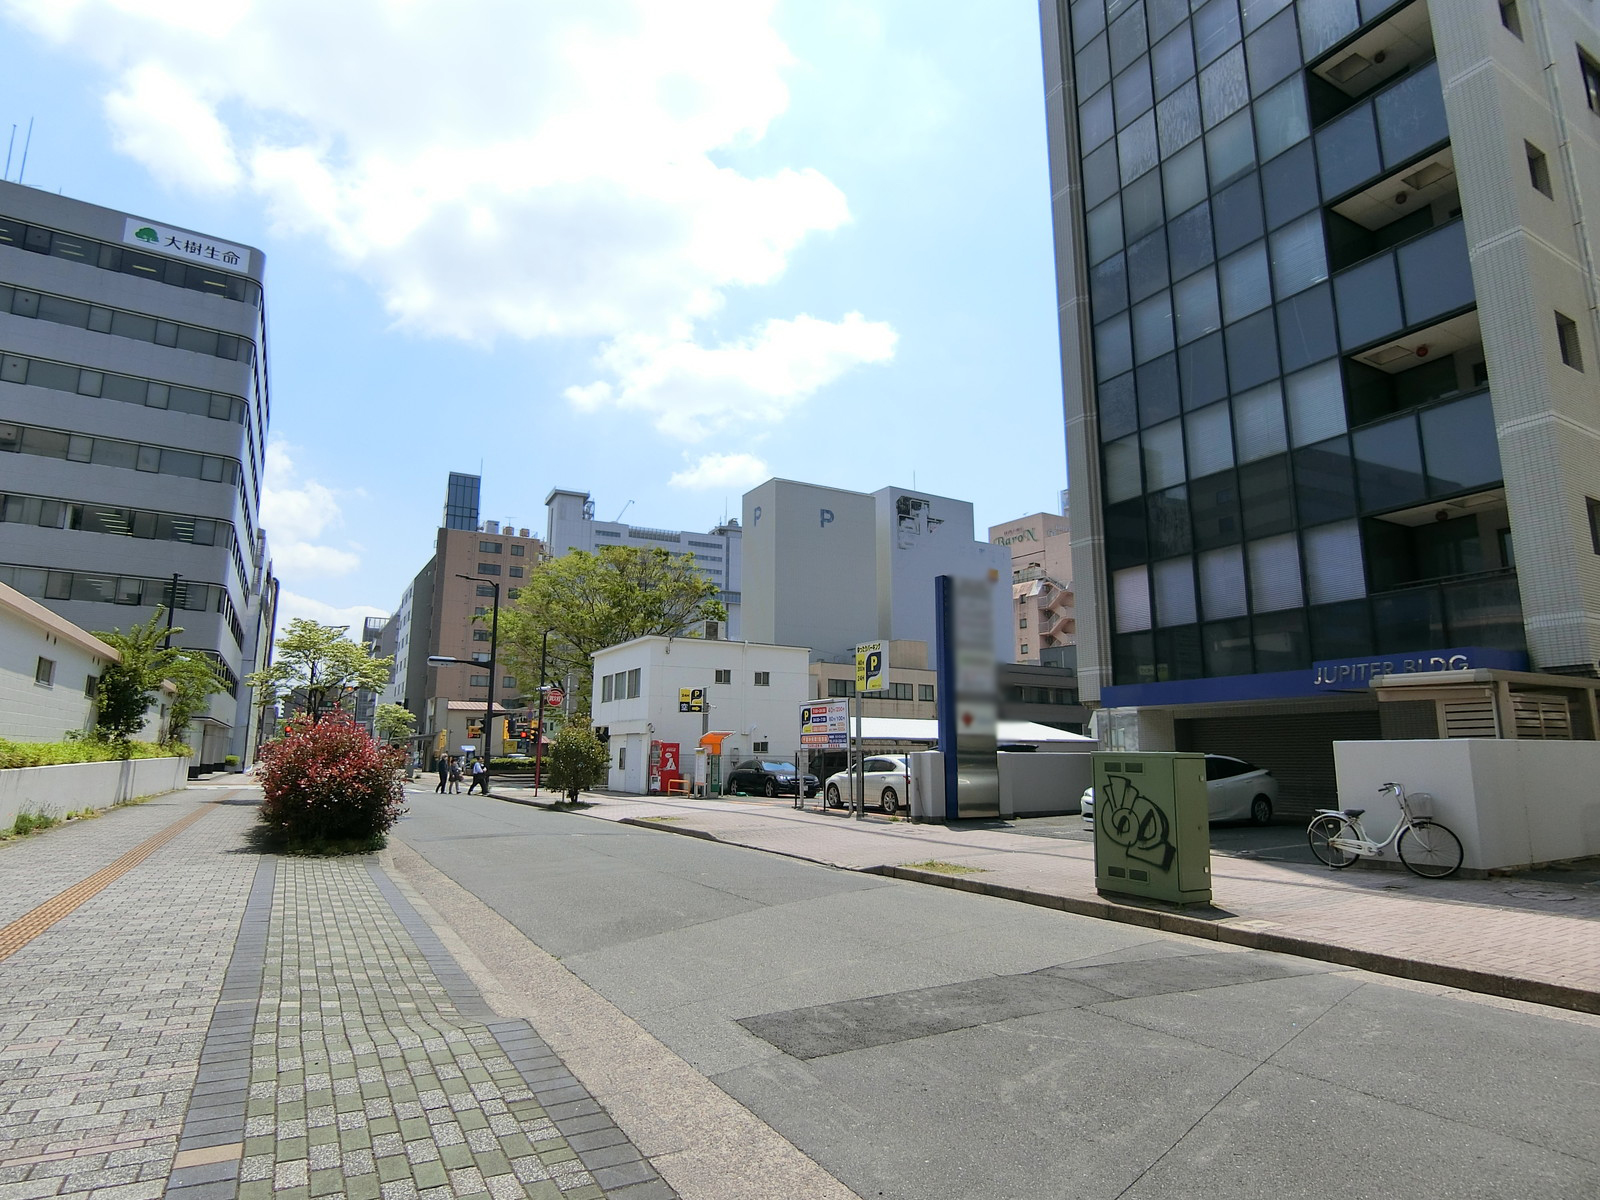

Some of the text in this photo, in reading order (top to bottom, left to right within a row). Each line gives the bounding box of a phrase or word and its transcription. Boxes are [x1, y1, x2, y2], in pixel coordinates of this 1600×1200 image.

[164, 236, 241, 265] 大樹生命
[754, 506, 762, 527] P
[820, 508, 835, 528] P
[870, 655, 878, 671] P
[1314, 661, 1394, 685] JUPITER
[804, 710, 809, 721] P
